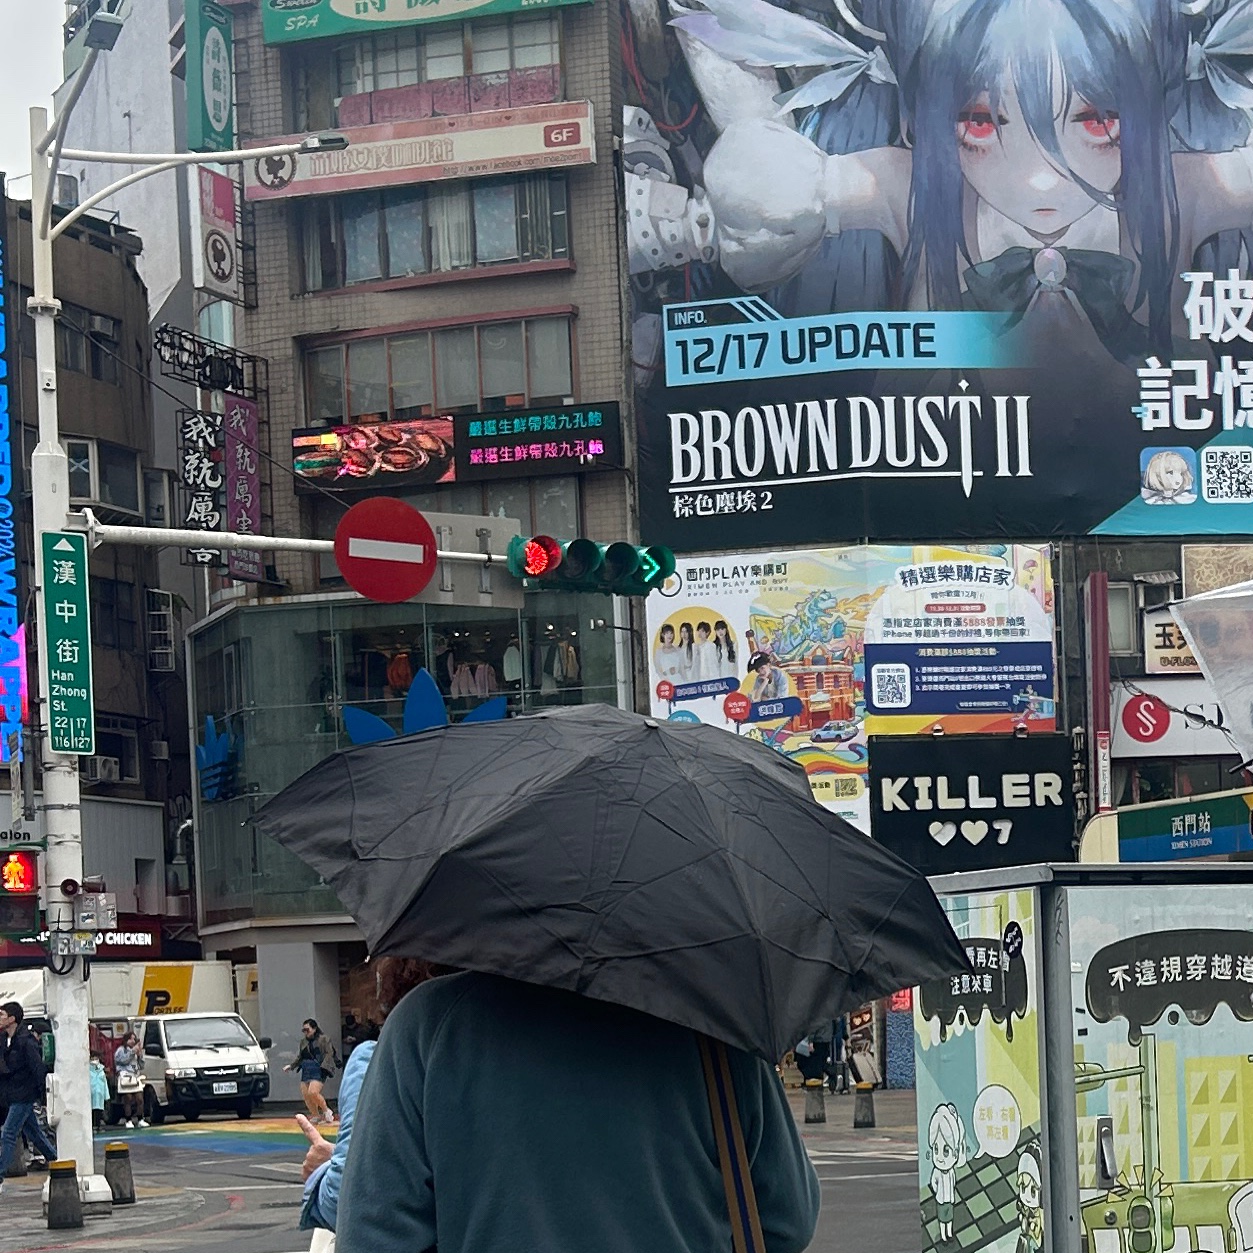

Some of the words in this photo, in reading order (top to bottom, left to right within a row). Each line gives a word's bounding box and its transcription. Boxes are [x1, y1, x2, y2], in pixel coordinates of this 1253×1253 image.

[285, 14, 319, 31] SPA
[550, 128, 575, 142] 6F
[674, 310, 707, 325] INFO.
[675, 332, 769, 376] 12/17
[781, 322, 936, 365] UPDATE
[669, 397, 838, 484] BROWN
[847, 391, 982, 498] DUST
[994, 395, 1033, 477] II
[900, 565, 1012, 587] 精選樂購店家
[53, 560, 79, 664] 漢中街
[51, 670, 74, 681] Han
[51, 685, 87, 700] Zhong
[52, 700, 68, 712] St.
[54, 717, 68, 728] 22
[76, 717, 87, 729] 17
[54, 736, 70, 748] 116
[75, 737, 90, 748] 127
[881, 771, 1064, 813] KILLER
[1171, 811, 1211, 837] 西門站
[993, 820, 1012, 845] 7
[105, 932, 152, 946] CHICKEN
[951, 974, 993, 995] 注意來車
